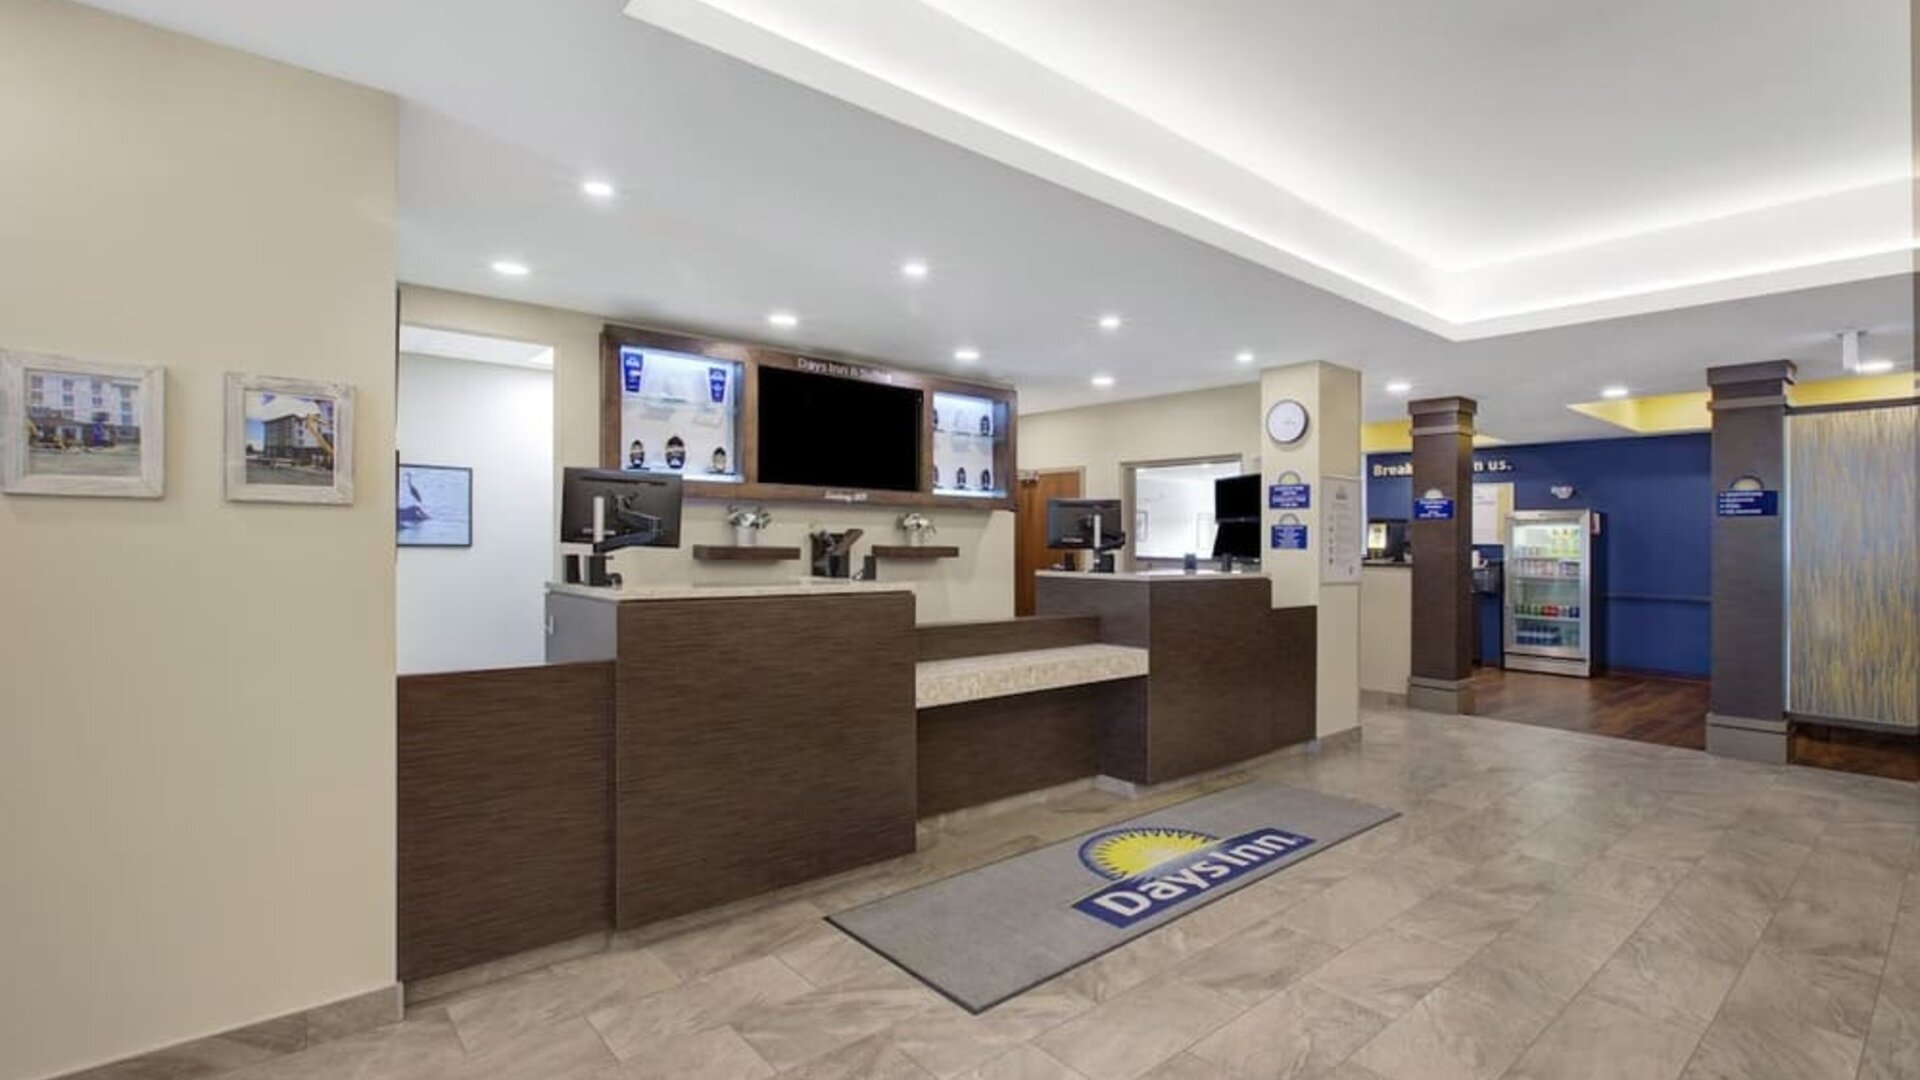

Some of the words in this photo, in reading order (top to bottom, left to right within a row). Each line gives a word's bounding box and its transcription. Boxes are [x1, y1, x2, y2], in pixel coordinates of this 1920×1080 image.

[797, 357, 827, 375] Days
[828, 362, 848, 377] Inn
[1487, 459, 1513, 471] us.
[1092, 860, 1231, 917] Days
[1209, 834, 1297, 868] Inn
